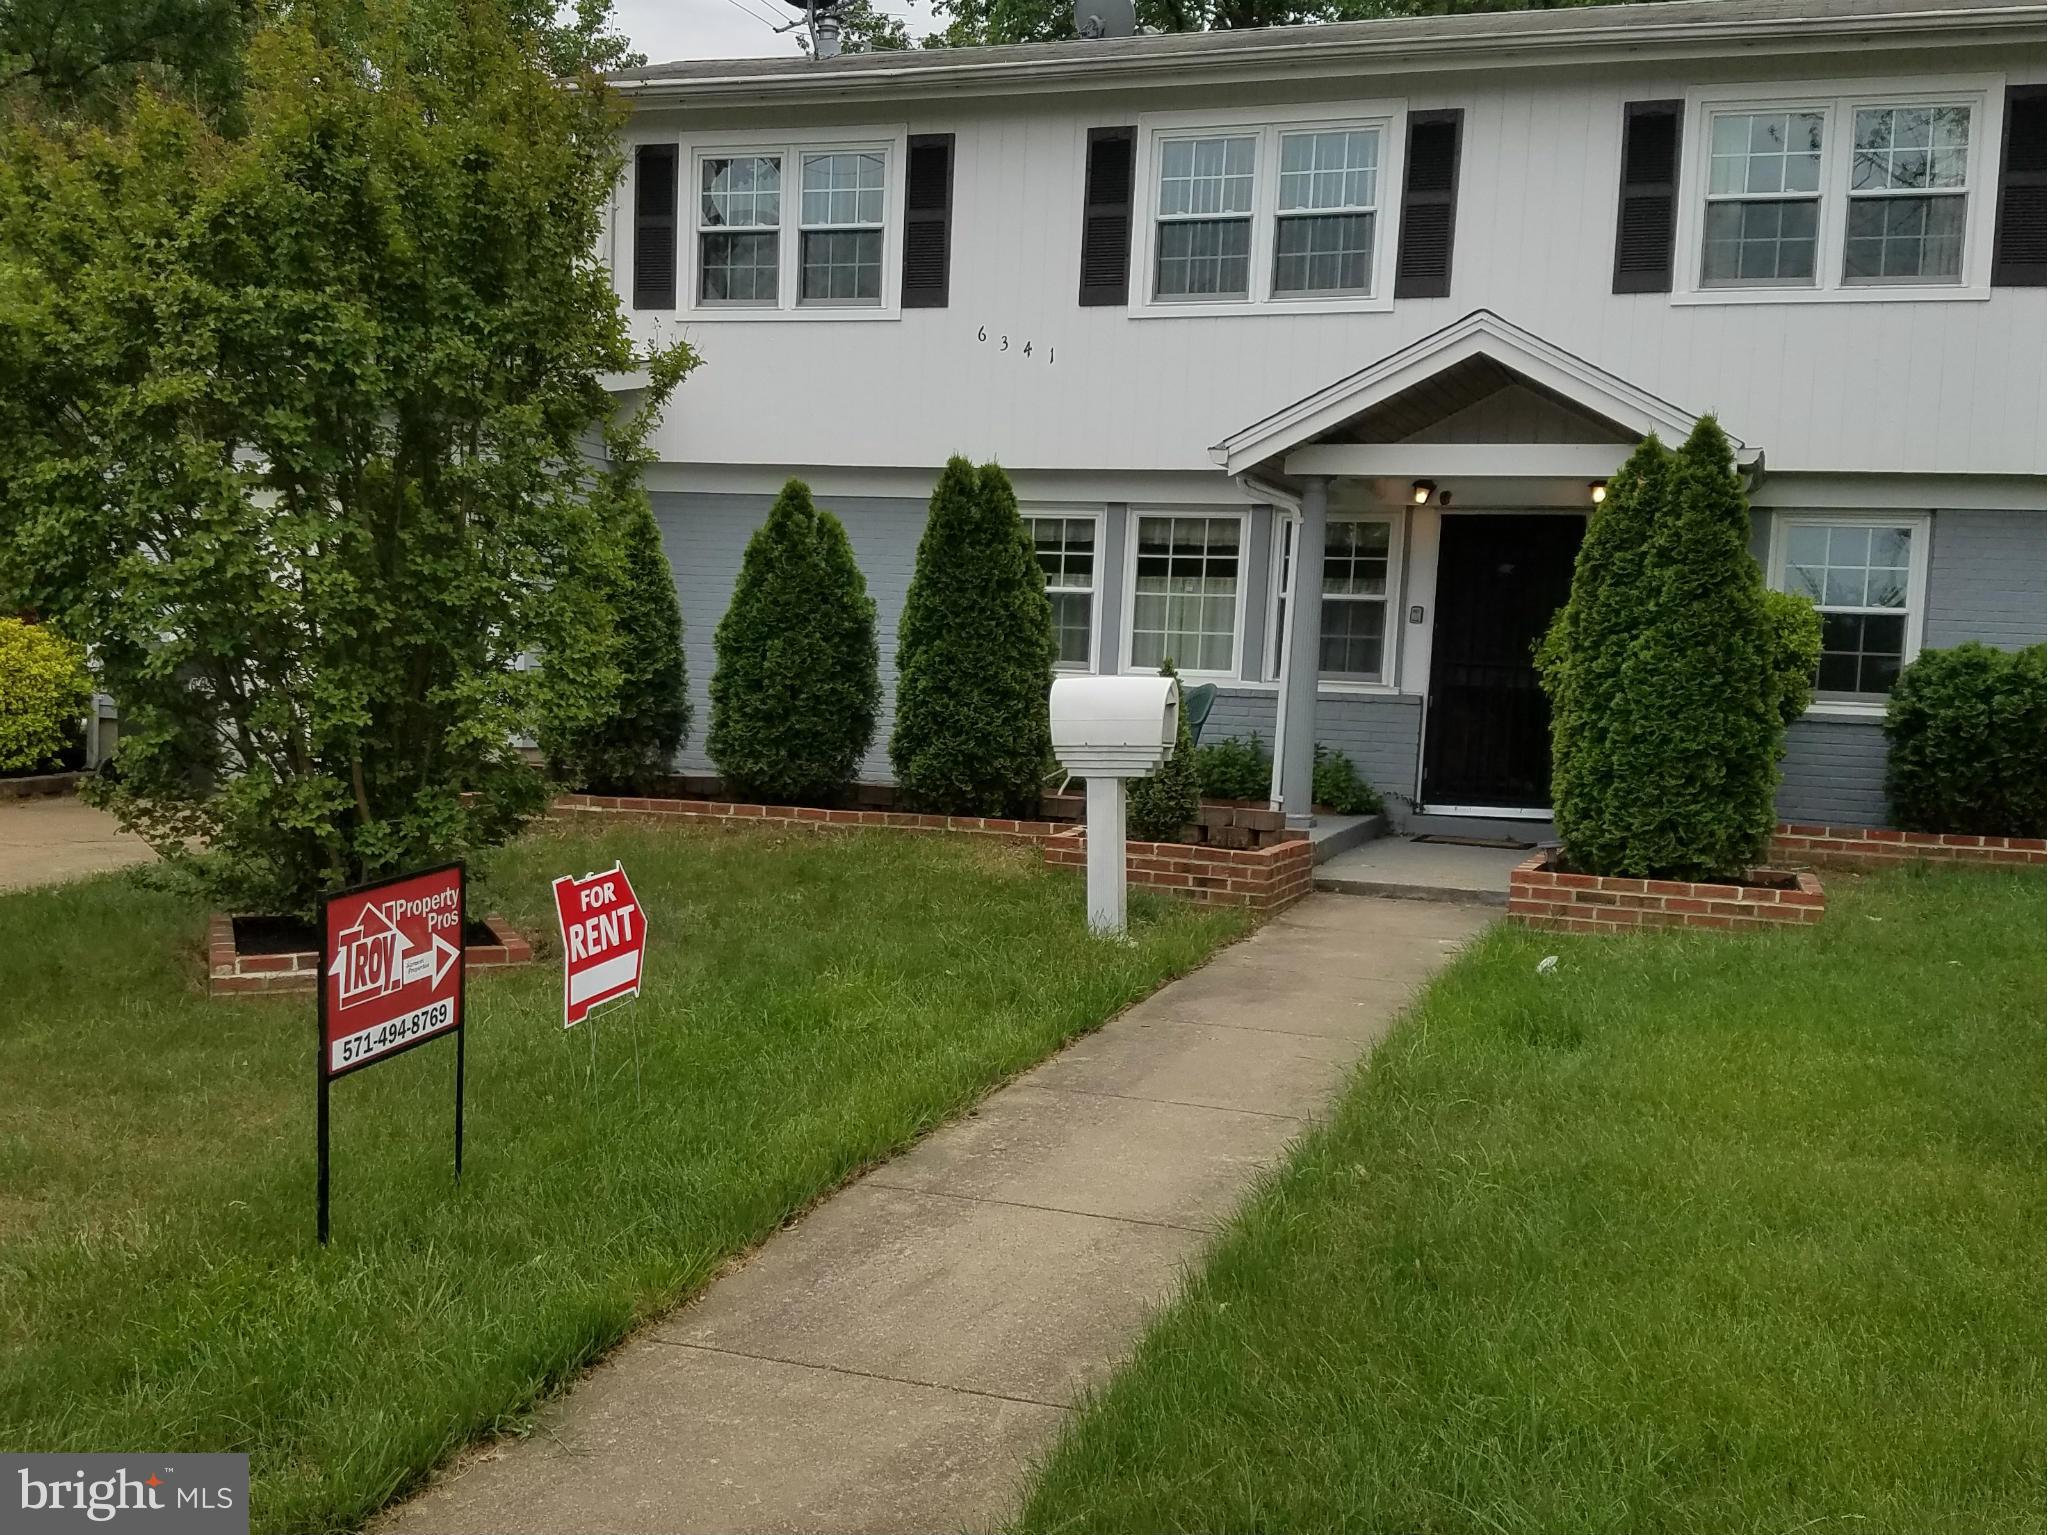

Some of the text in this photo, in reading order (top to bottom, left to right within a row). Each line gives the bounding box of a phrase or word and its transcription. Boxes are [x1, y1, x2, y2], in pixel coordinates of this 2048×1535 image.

[977, 325, 1054, 364] 6341
[396, 886, 460, 921] Property
[580, 881, 617, 912] FOR
[428, 909, 459, 933] Pros
[569, 904, 635, 963] RENT
[338, 932, 397, 995] TROY
[342, 1003, 448, 1062] 571-494-8769
